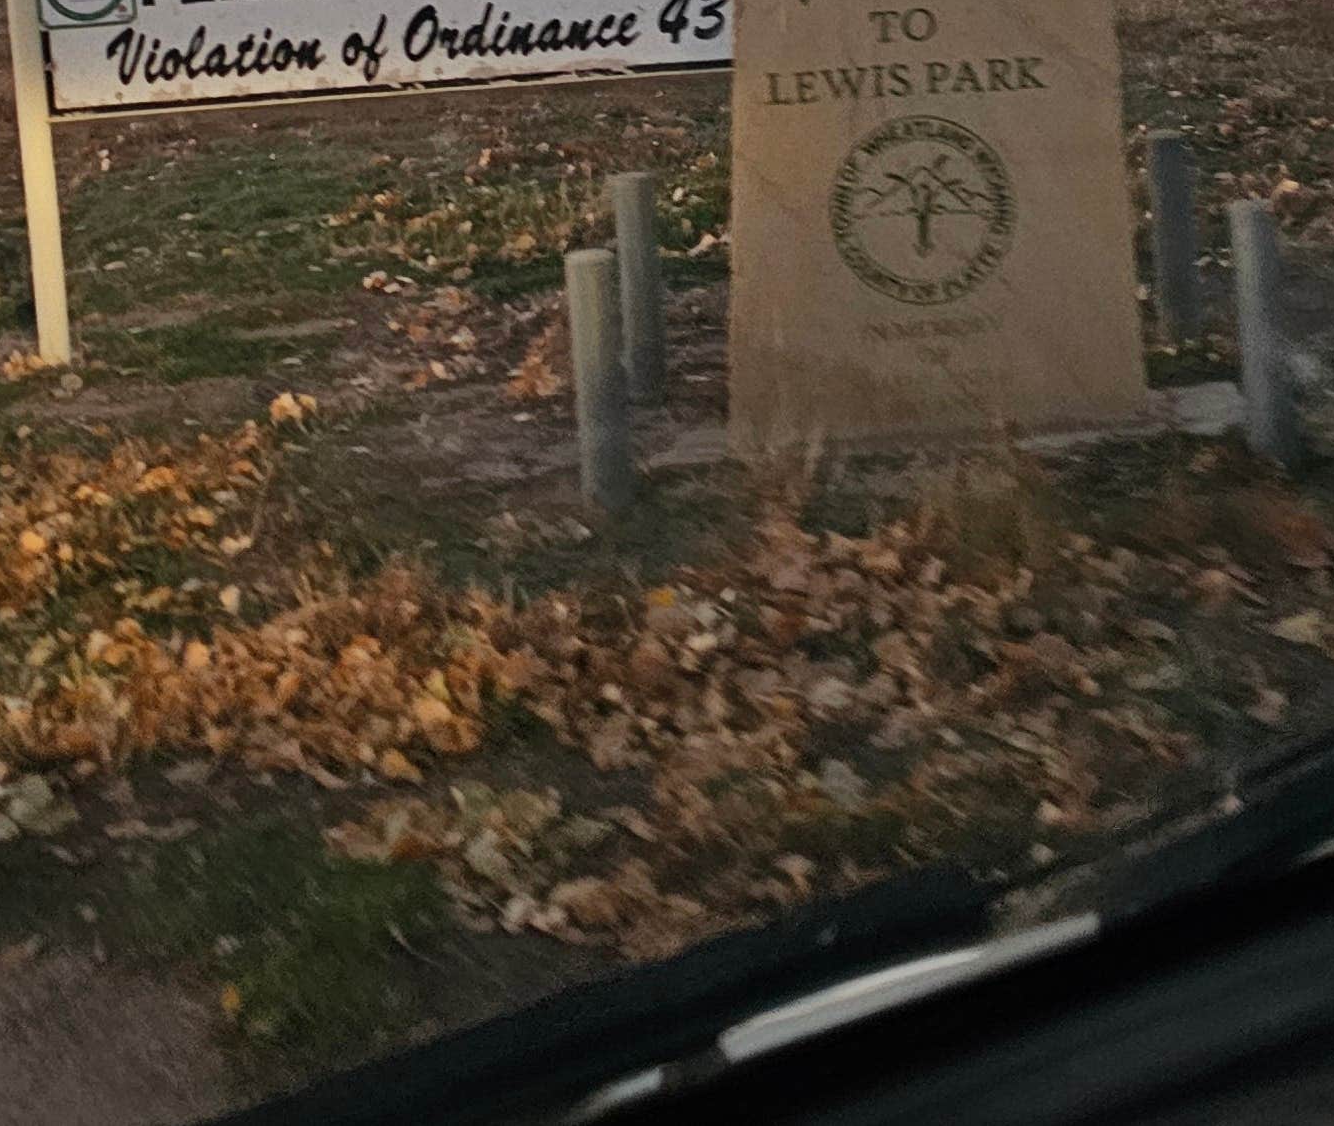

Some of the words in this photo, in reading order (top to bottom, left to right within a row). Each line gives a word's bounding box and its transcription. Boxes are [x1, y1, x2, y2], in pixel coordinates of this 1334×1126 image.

[106, 26, 326, 85] Violation
[342, 14, 388, 82] of
[402, 2, 641, 62] Ordinance
[869, 7, 938, 43] TO
[765, 61, 913, 105] LEWIS
[924, 56, 1048, 95] PARK
